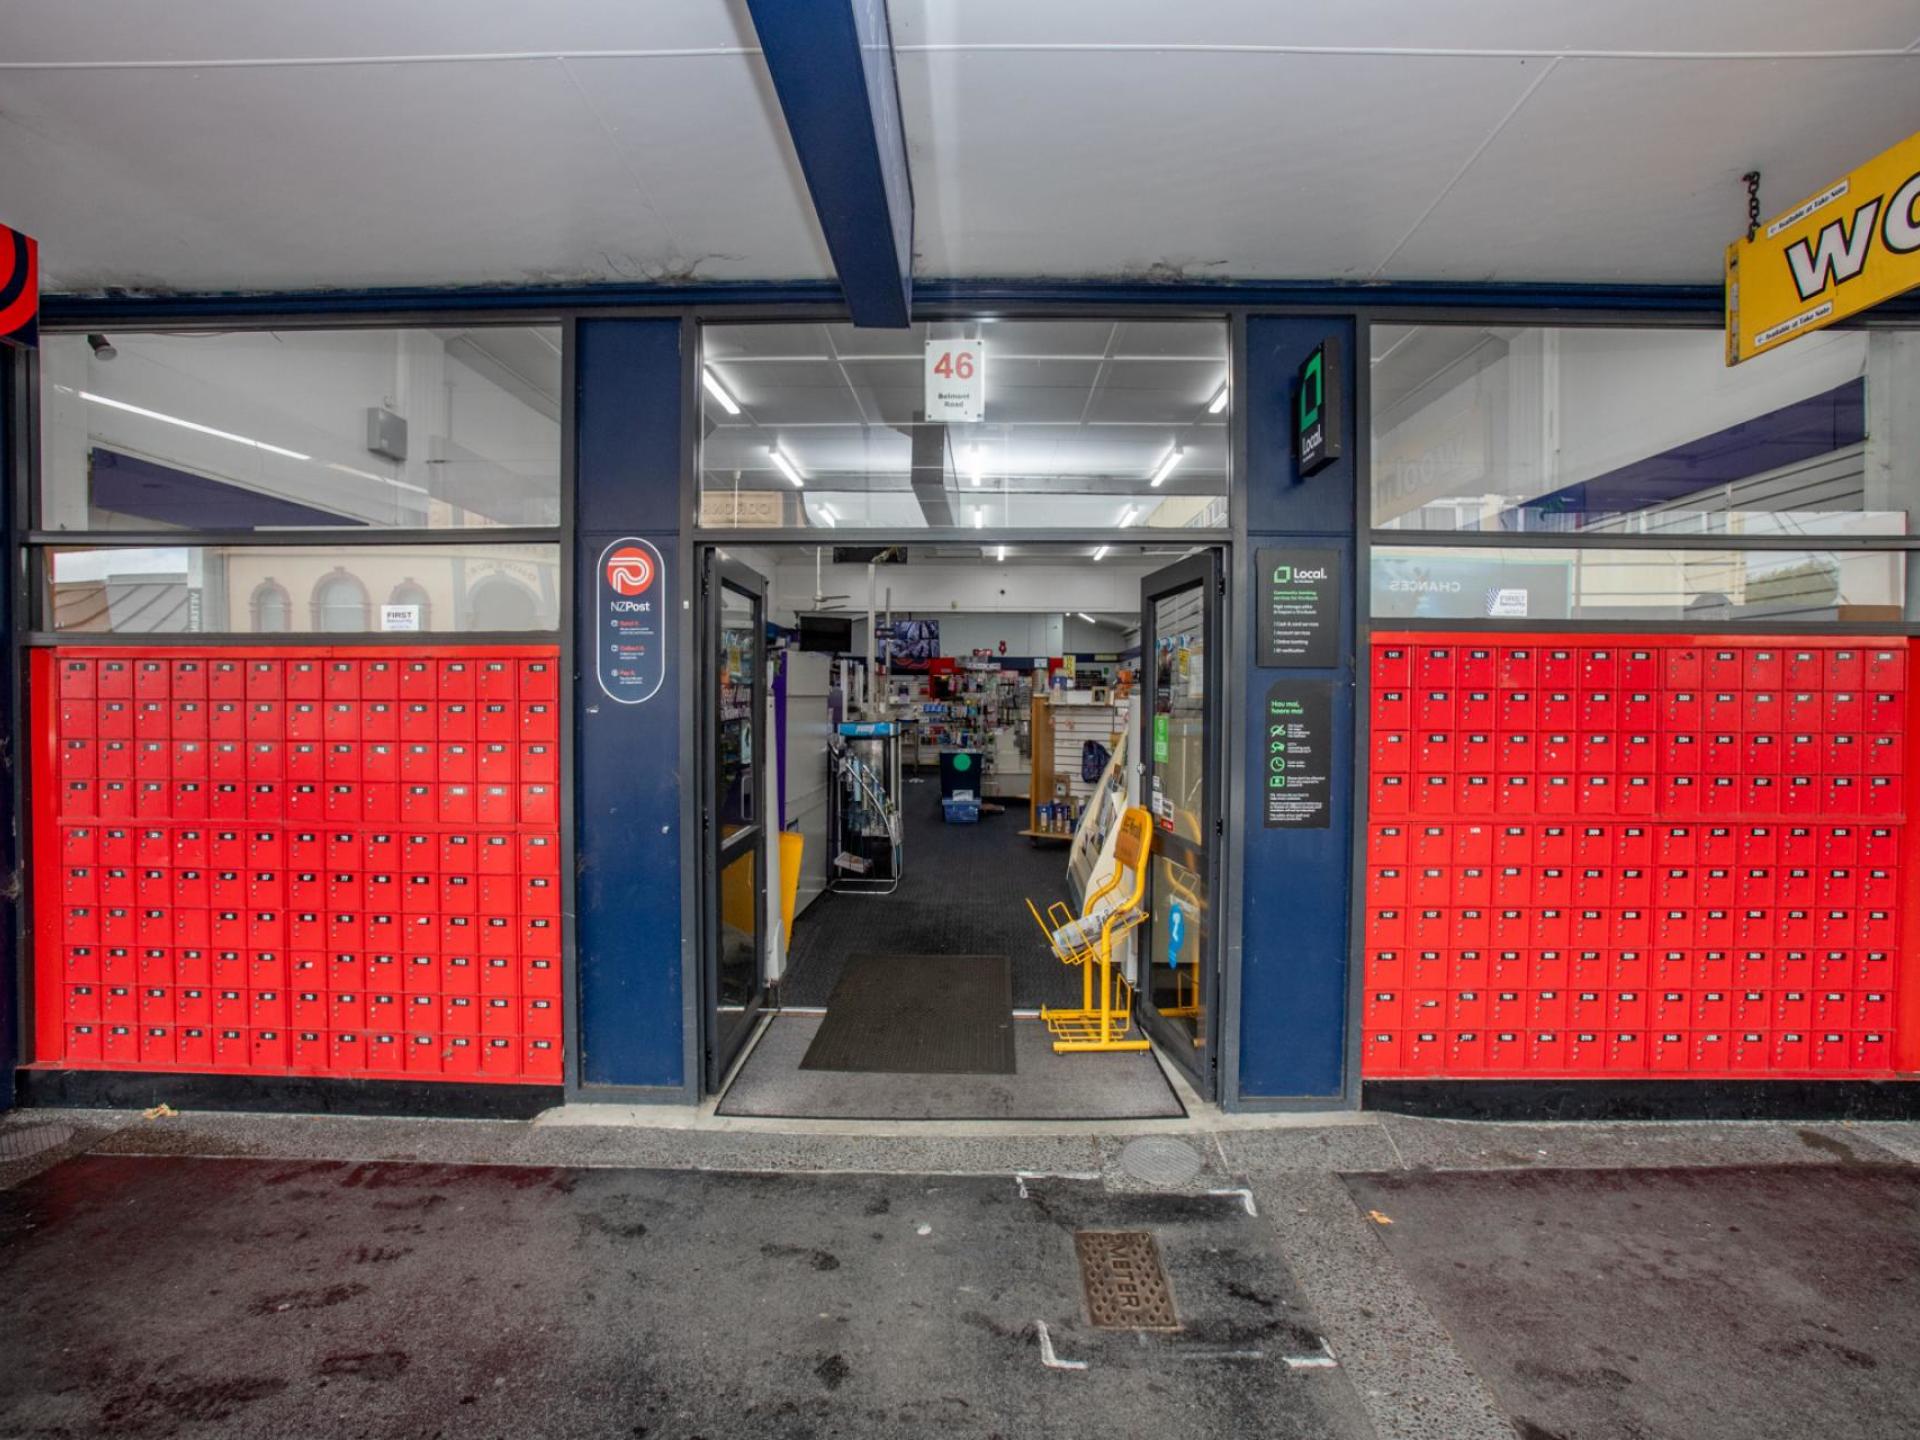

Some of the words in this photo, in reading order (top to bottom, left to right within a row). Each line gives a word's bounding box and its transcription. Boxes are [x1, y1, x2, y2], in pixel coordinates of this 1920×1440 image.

[934, 352, 974, 380] 46
[386, 611, 413, 619] FIRST
[1108, 1240, 1141, 1309] METER
